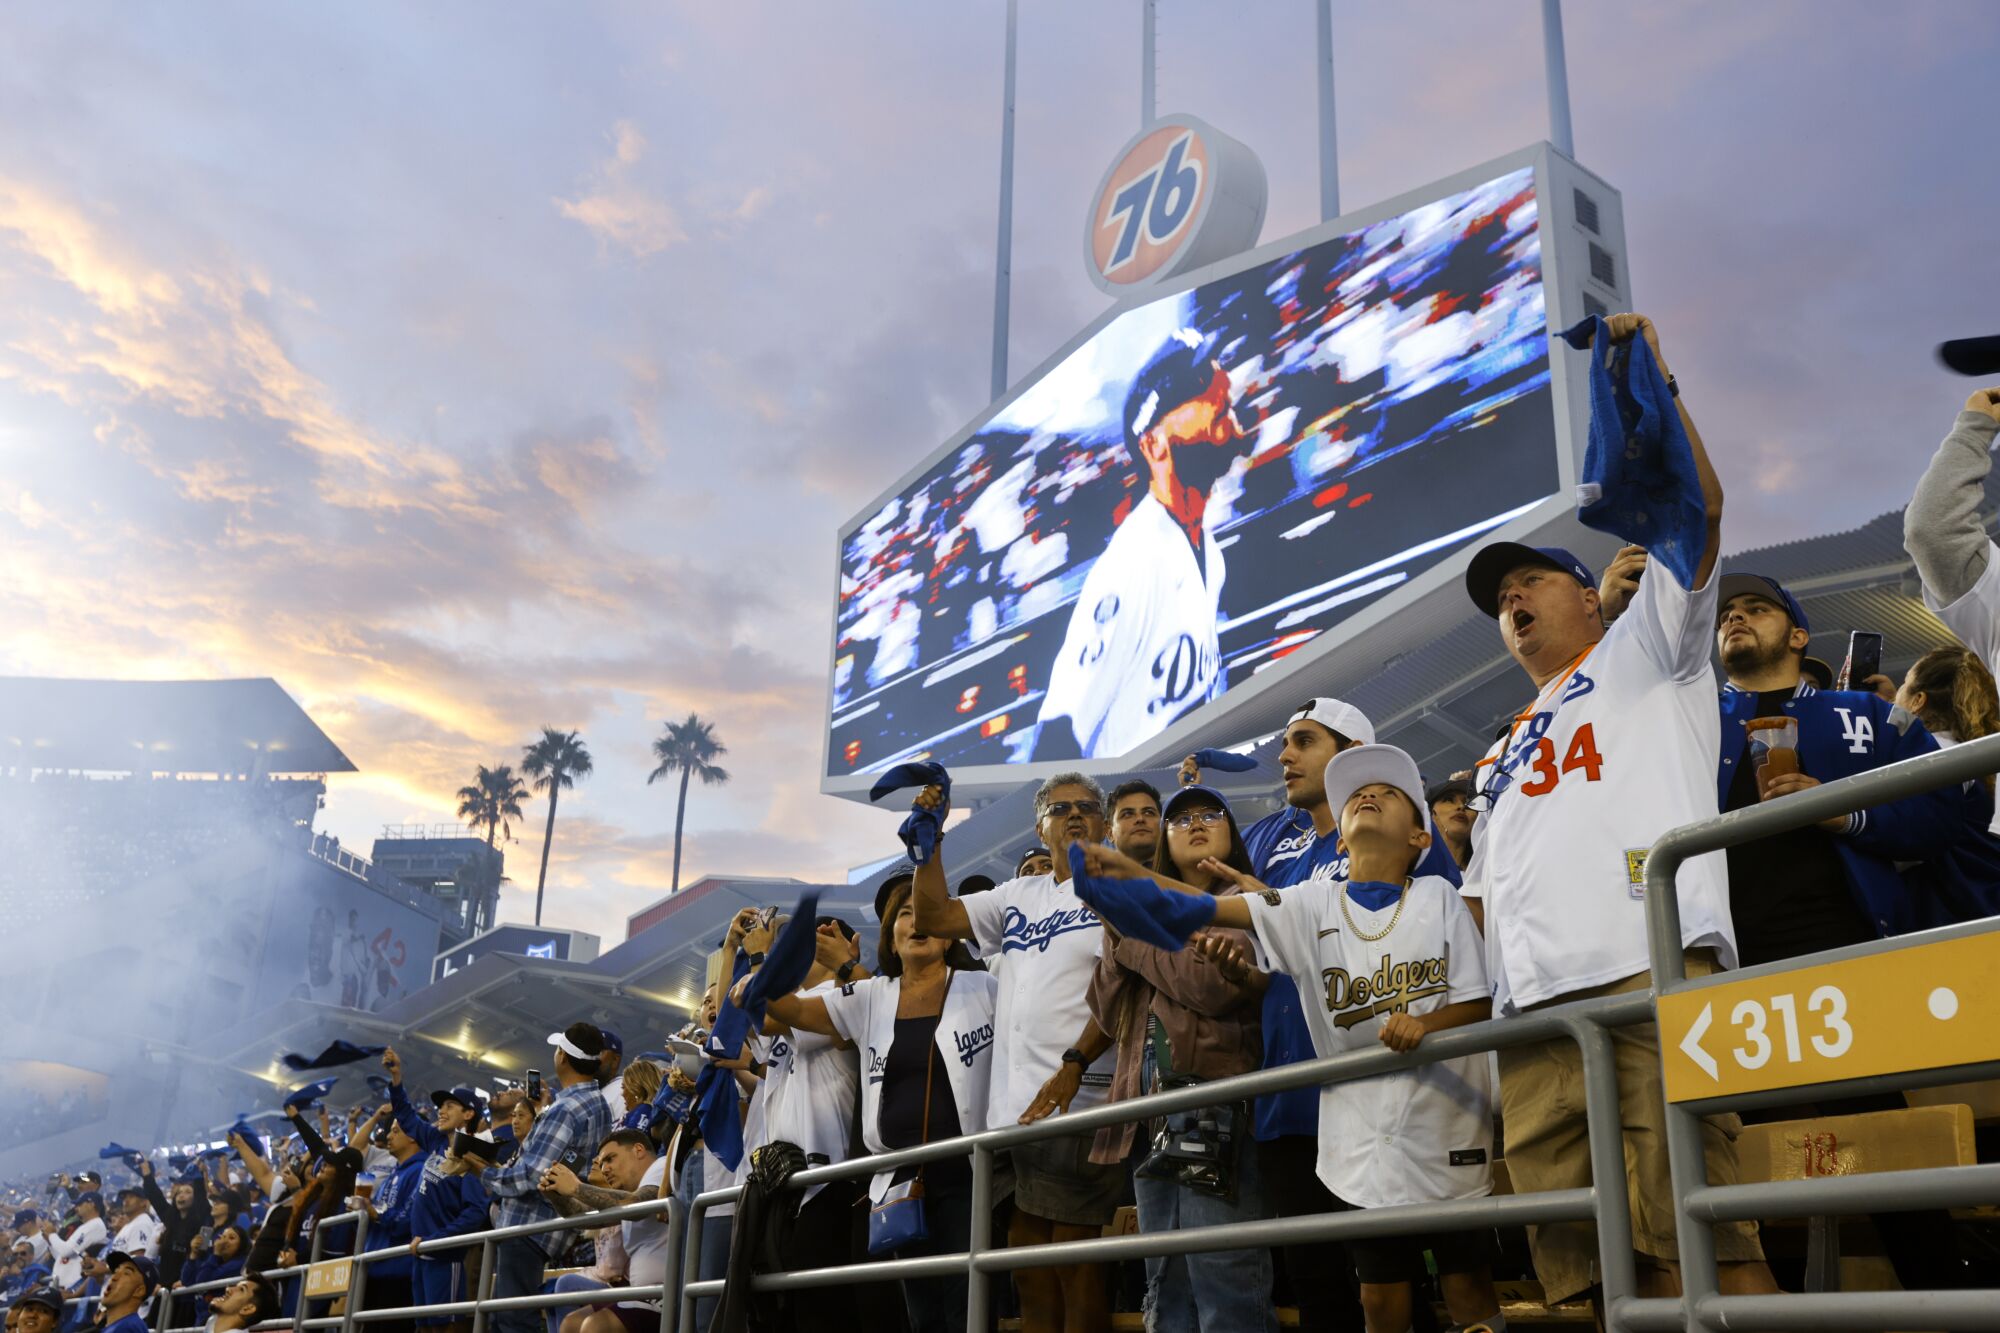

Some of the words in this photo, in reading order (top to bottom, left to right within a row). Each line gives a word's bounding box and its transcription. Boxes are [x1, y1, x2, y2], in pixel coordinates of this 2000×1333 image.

[1104, 130, 1202, 275] 76
[1521, 722, 1603, 797] 34
[1833, 707, 1874, 754] LA
[1731, 985, 1853, 1069] 313
[1804, 1133, 1837, 1177] 18
